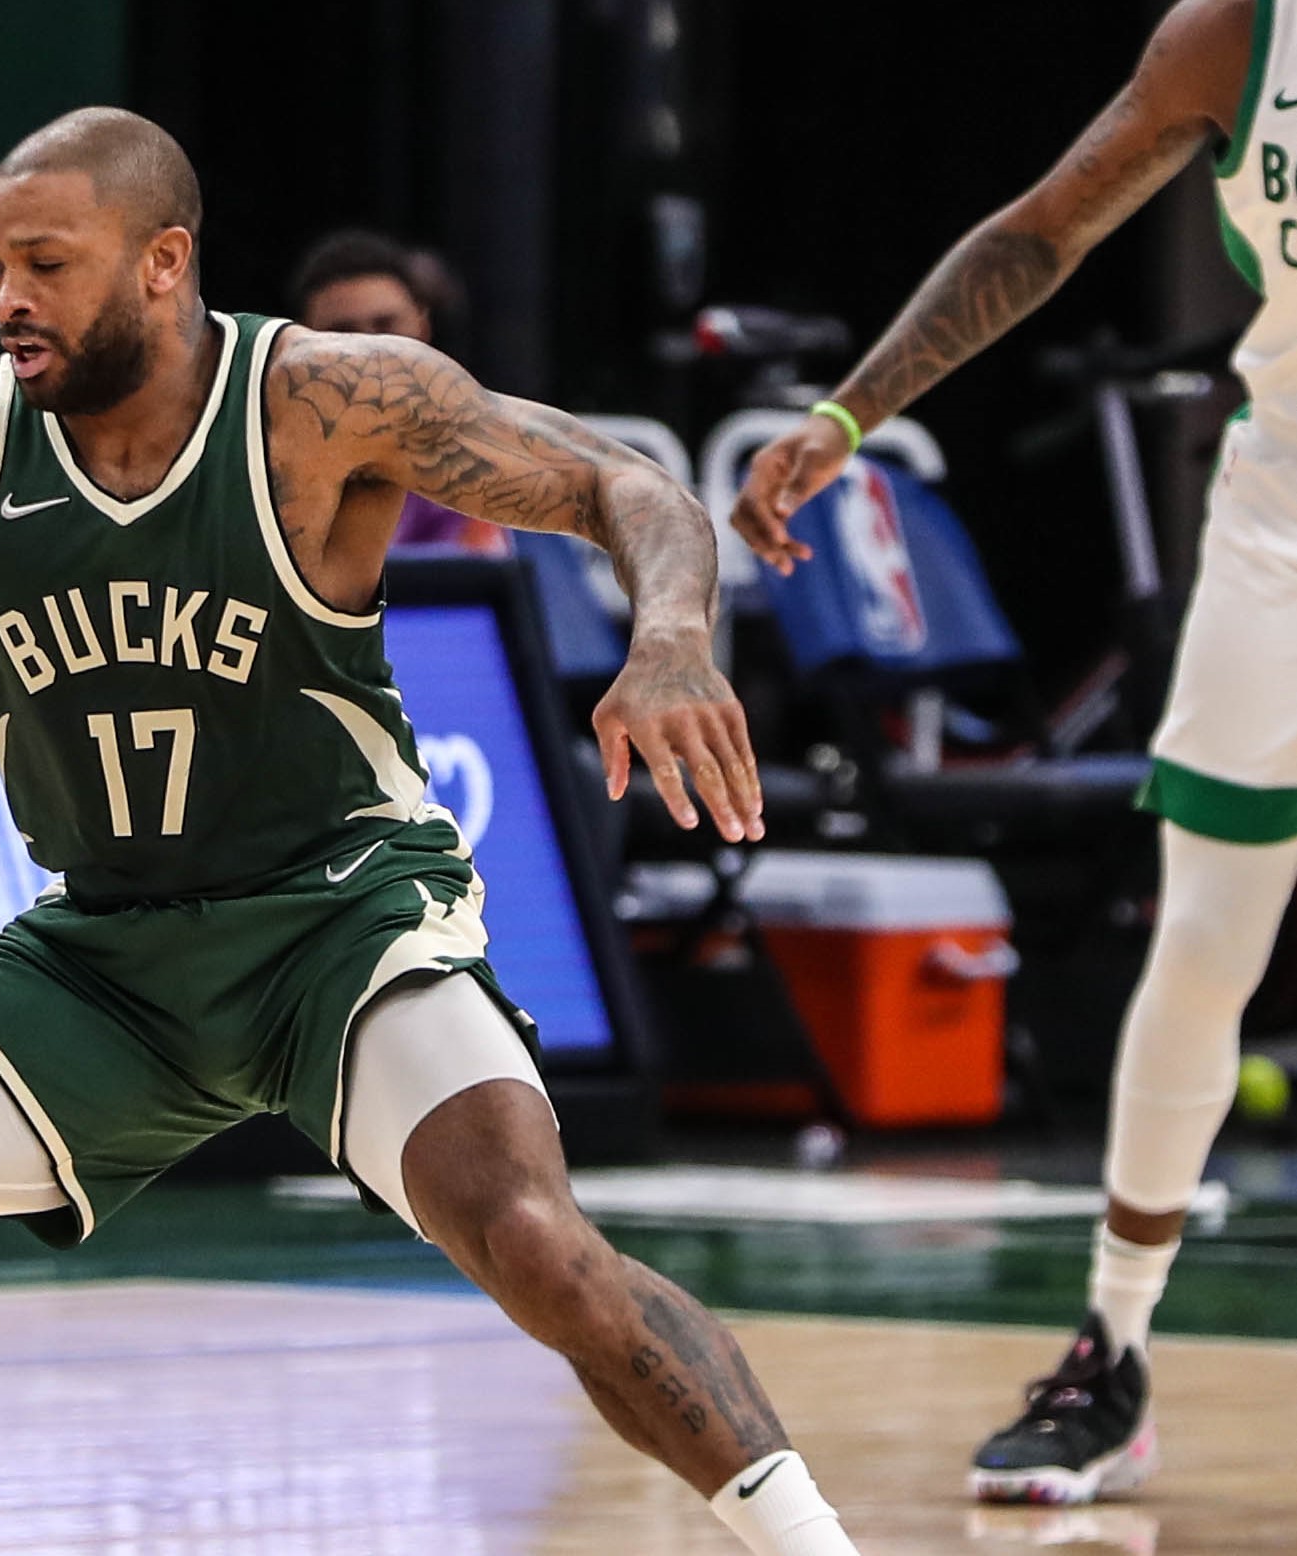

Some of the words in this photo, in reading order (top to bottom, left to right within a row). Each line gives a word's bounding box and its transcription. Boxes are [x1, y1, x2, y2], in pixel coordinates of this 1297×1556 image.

[1262, 141, 1297, 203] B
[87, 708, 195, 836] 17
[631, 1345, 662, 1379] 03
